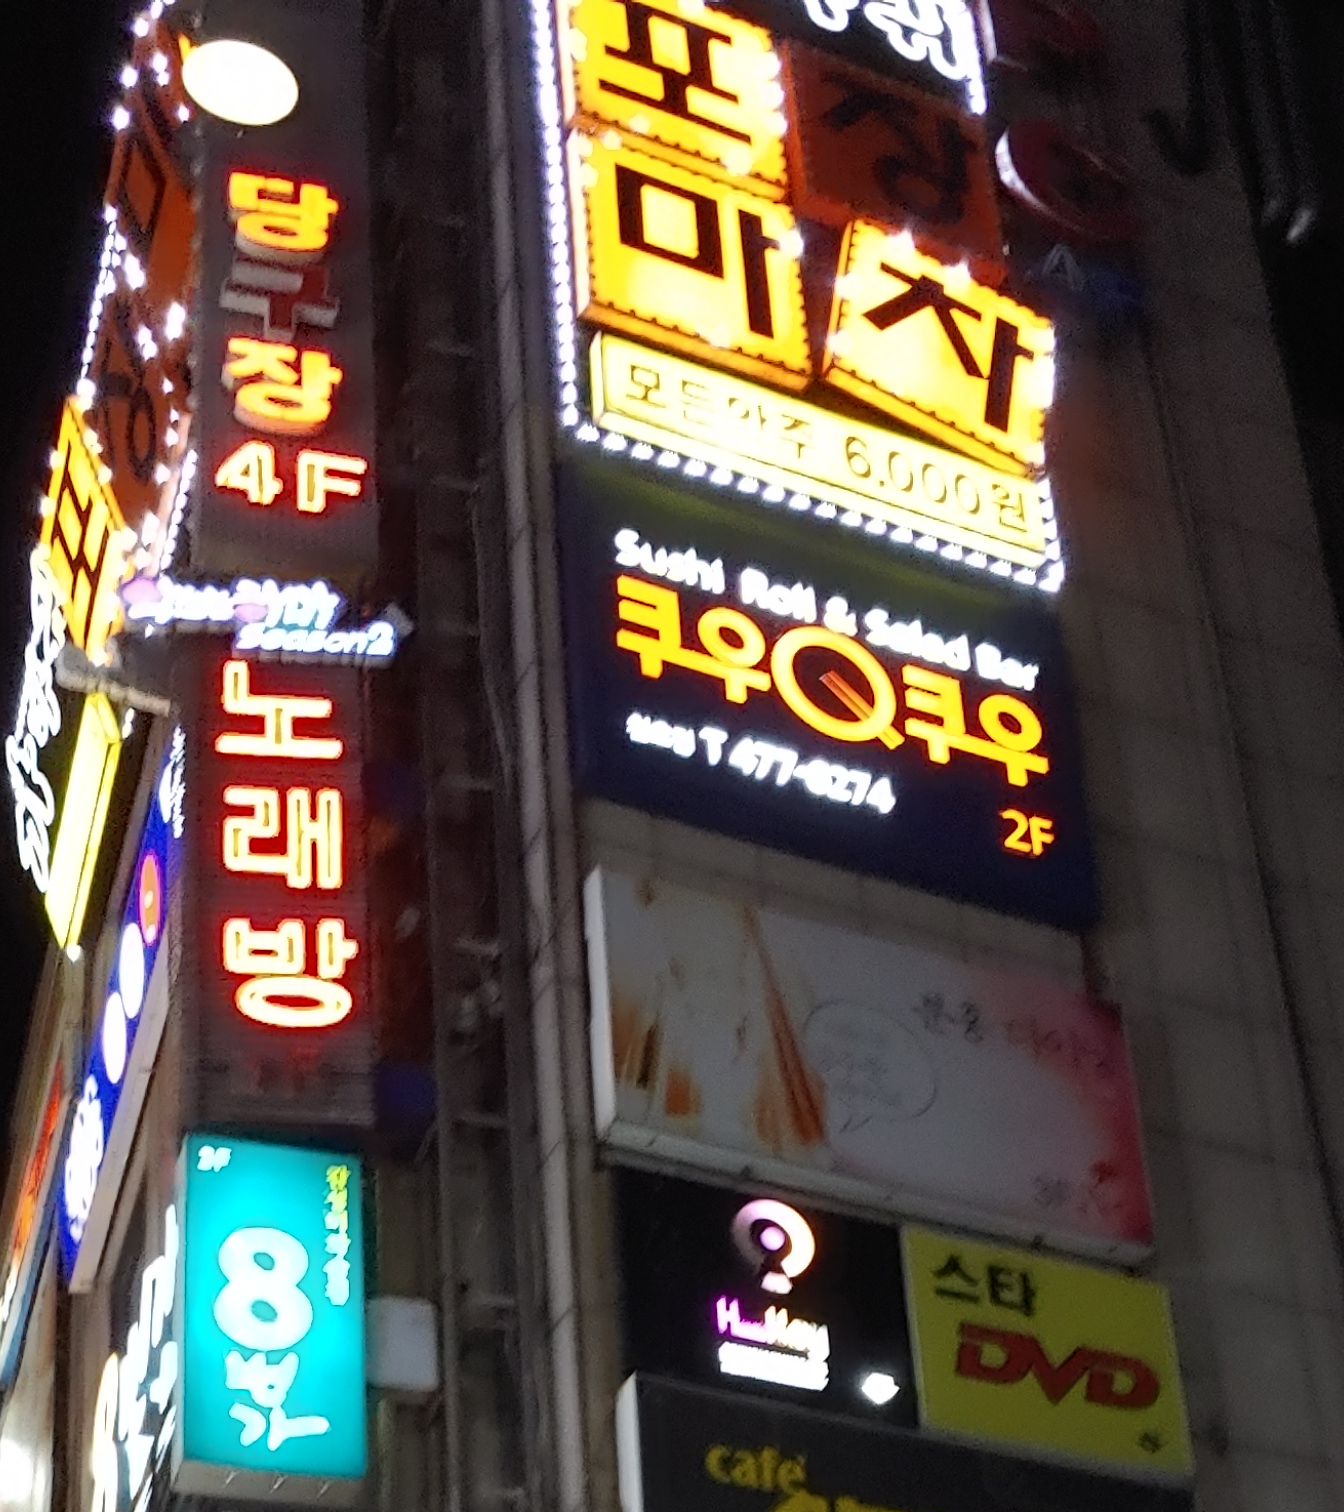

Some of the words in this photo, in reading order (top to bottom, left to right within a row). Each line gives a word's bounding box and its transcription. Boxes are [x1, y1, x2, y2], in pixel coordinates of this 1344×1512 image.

[214, 440, 368, 514] 4F
[614, 529, 726, 595] Sushi
[215, 659, 359, 1028] 노래방
[998, 807, 1056, 858] 2F
[933, 1251, 1039, 1318] 스타
[954, 1320, 1163, 1411] DVD
